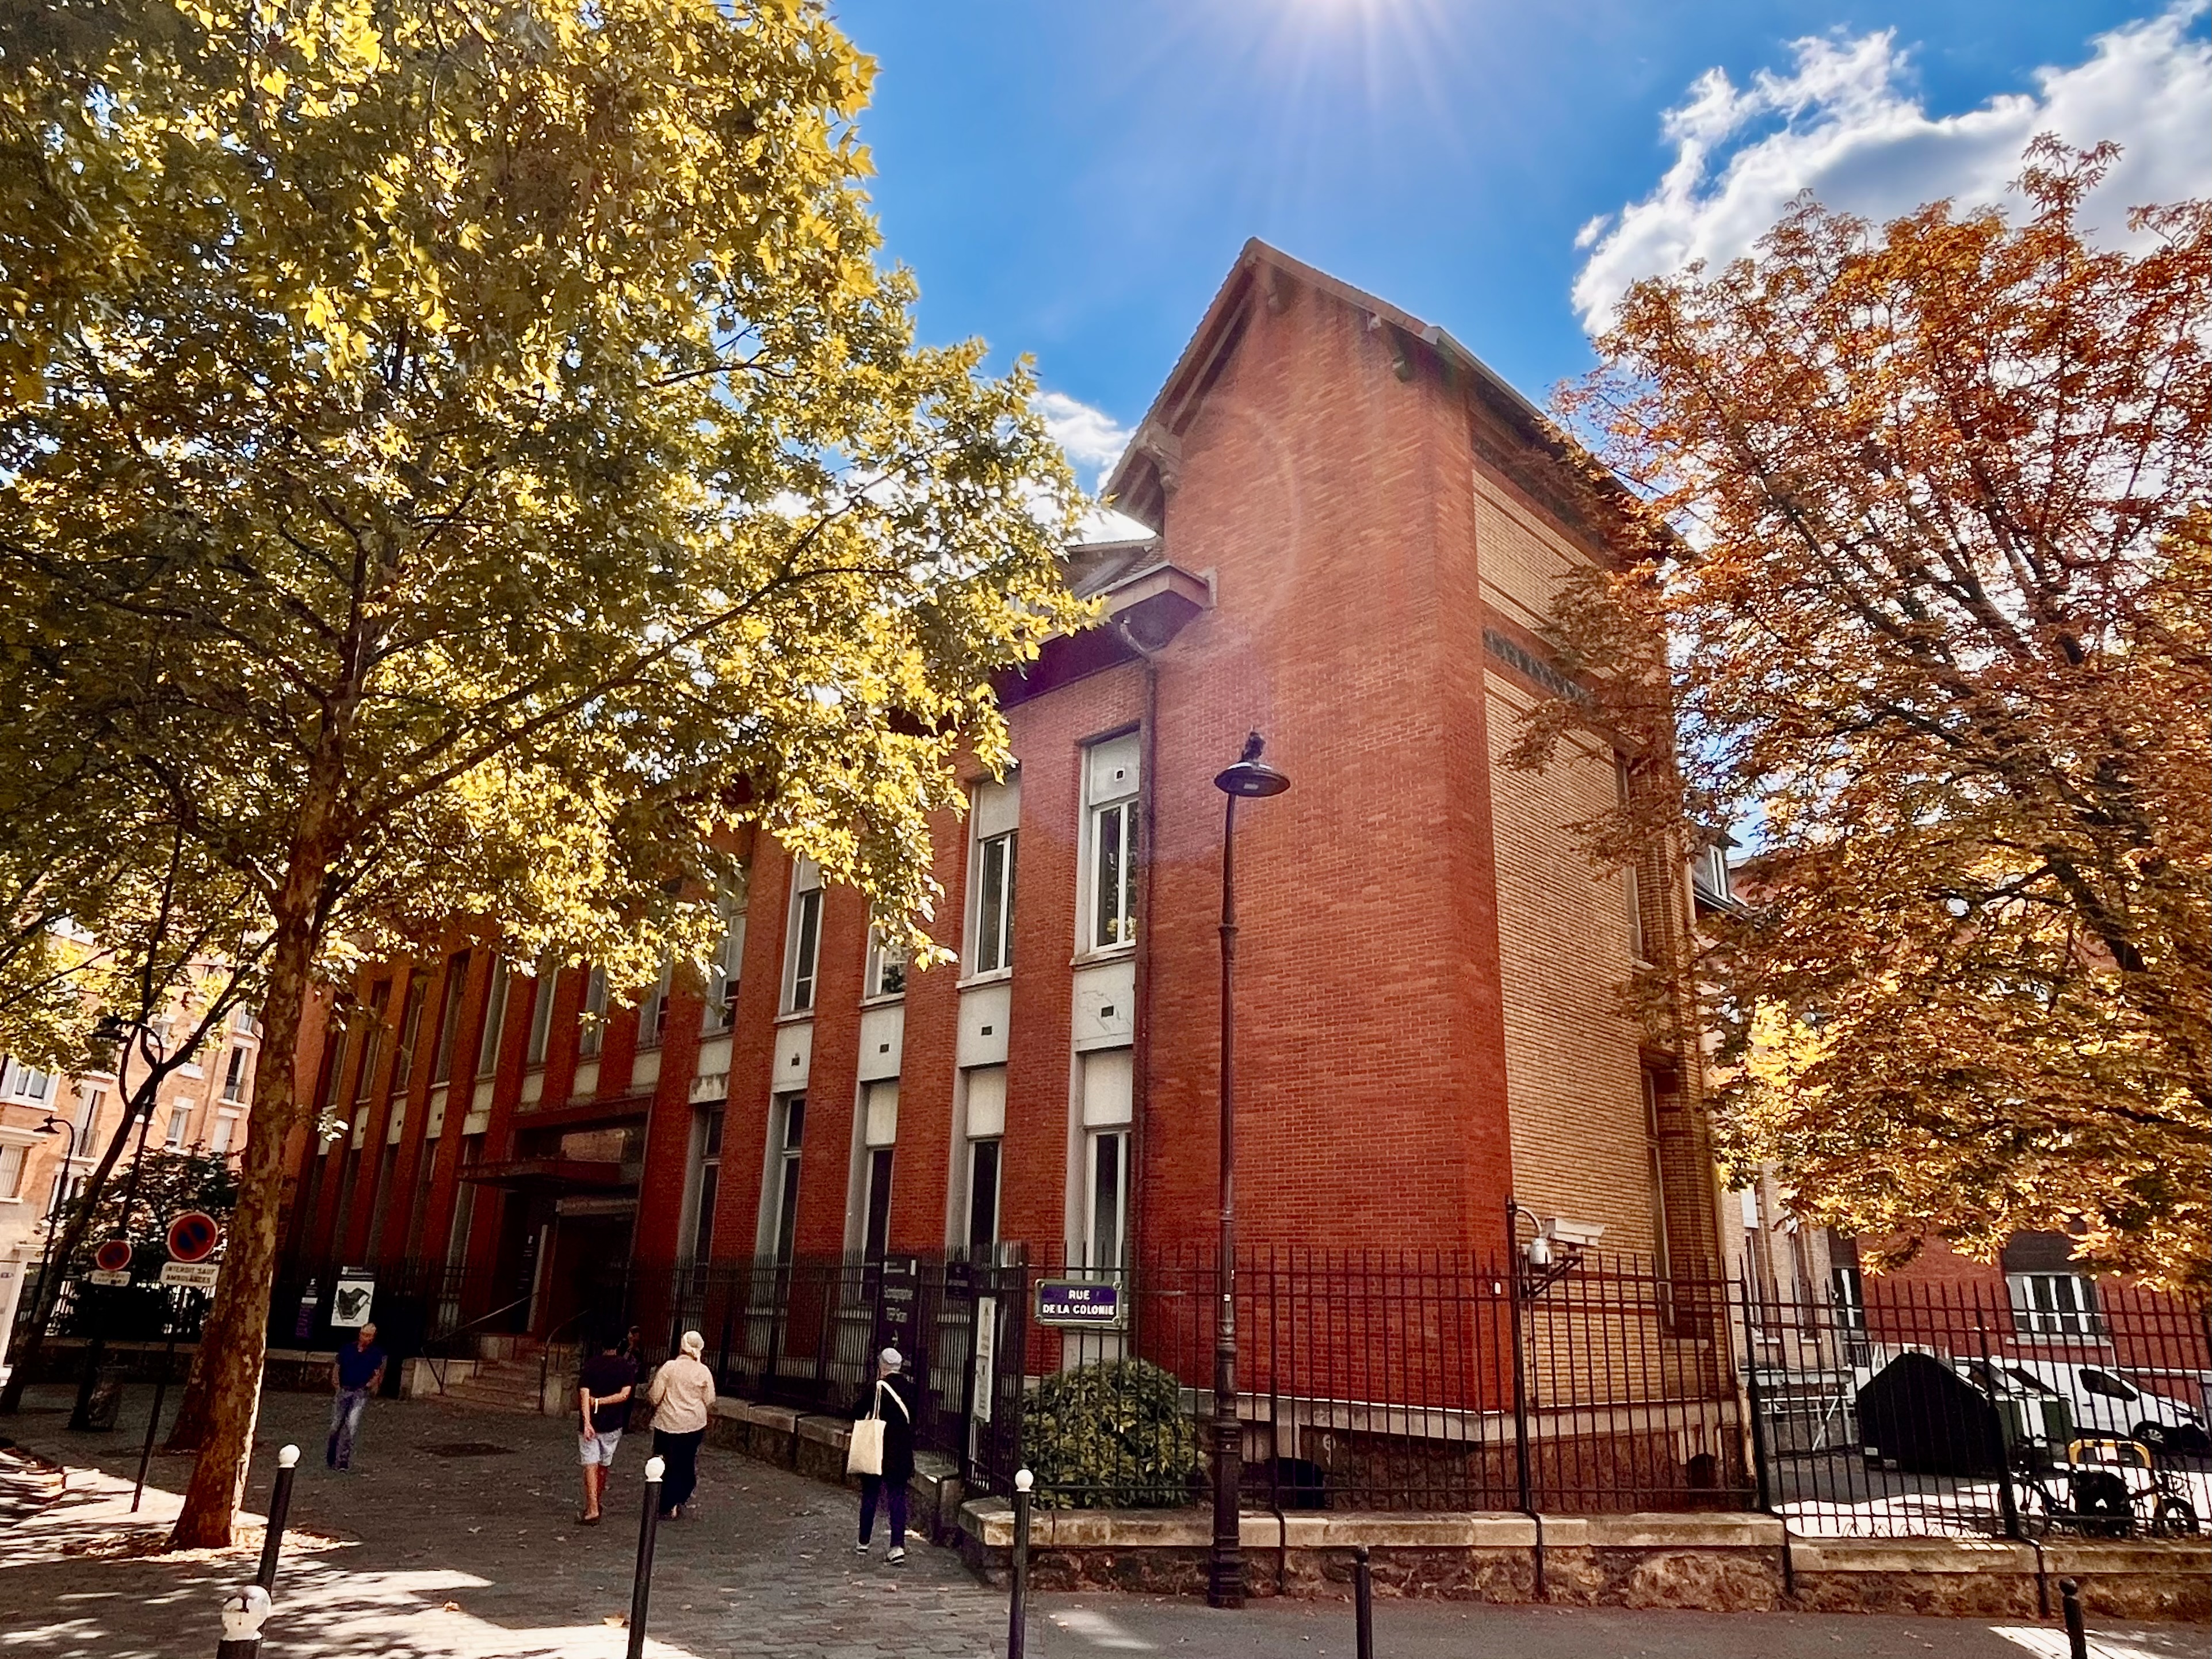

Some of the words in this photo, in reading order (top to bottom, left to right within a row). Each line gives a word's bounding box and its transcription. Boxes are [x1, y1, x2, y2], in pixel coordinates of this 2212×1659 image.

[1068, 1290, 1090, 1300] RUE
[1042, 1304, 1055, 1313] DE
[1057, 1304, 1070, 1314] LA
[1072, 1304, 1114, 1315] COLONIE
